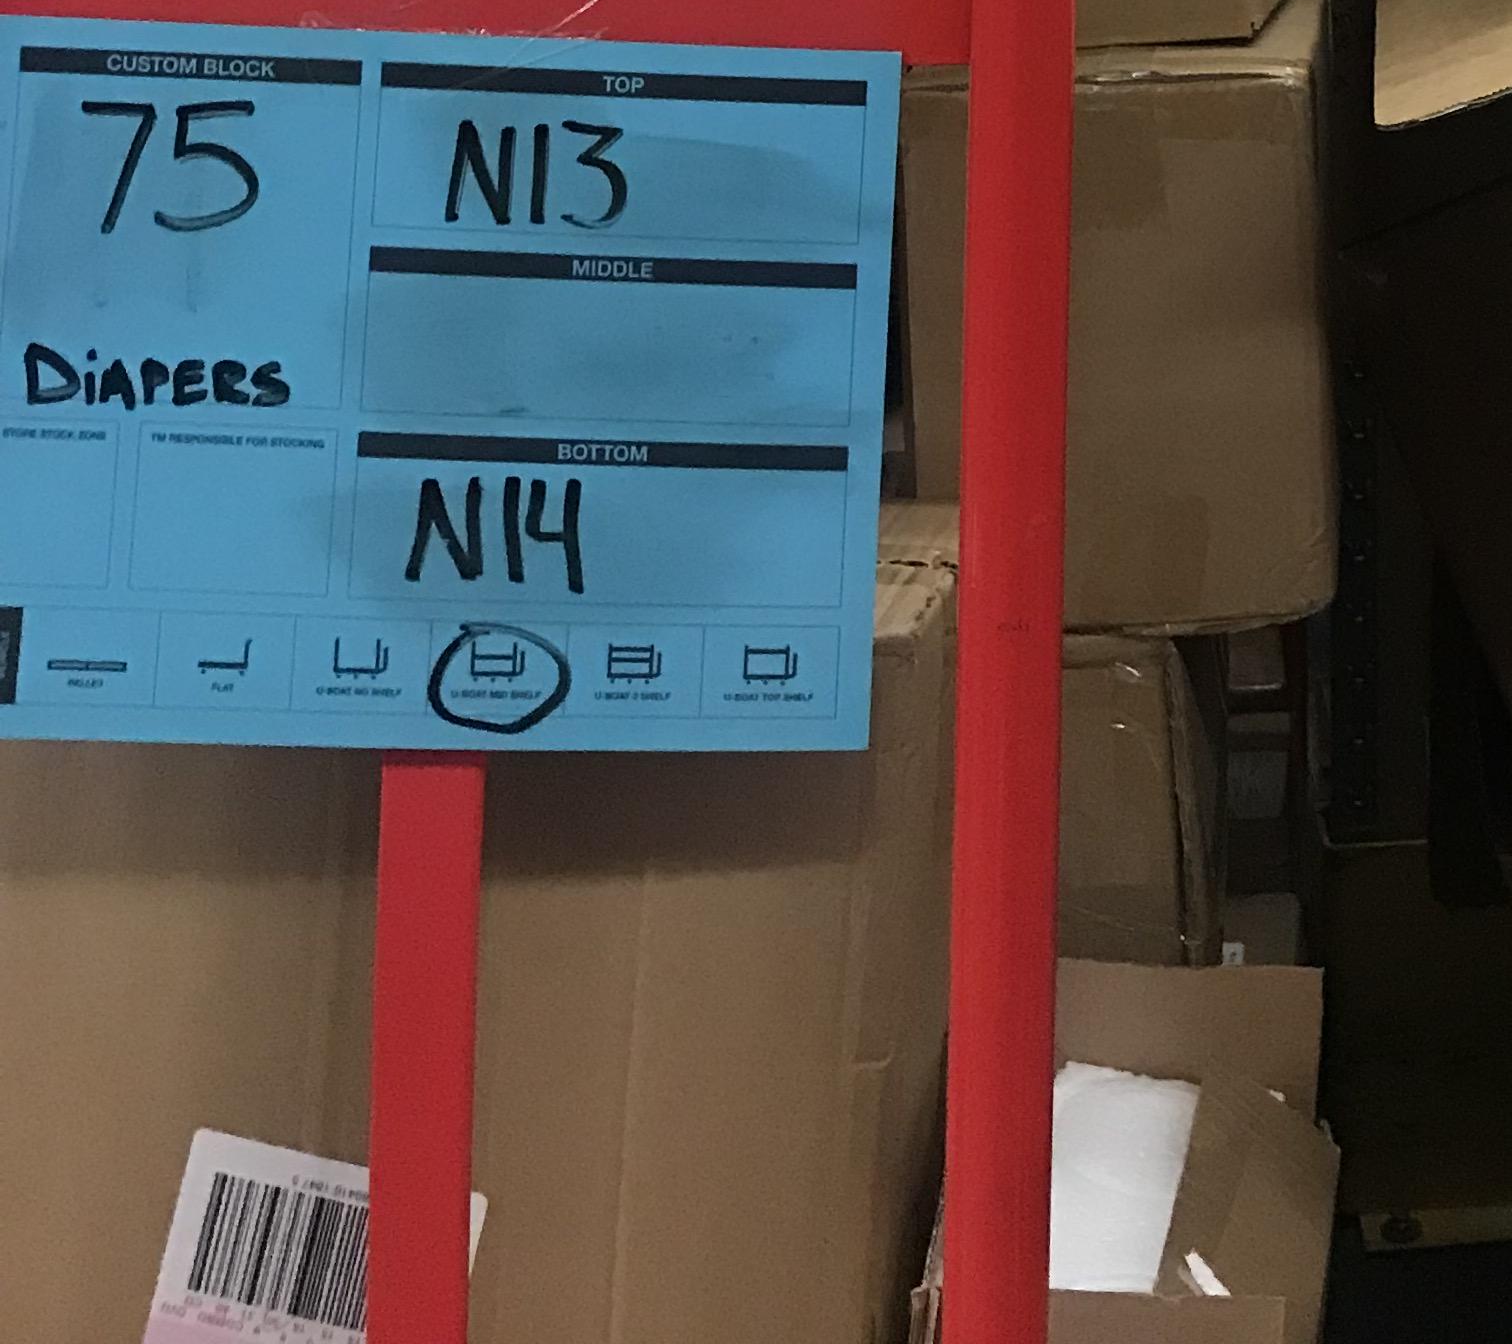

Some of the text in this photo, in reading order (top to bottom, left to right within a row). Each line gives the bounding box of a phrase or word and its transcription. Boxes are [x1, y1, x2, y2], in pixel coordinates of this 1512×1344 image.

[106, 53, 276, 80] CUSTOM BLOCK
[602, 75, 645, 95] TOP
[81, 100, 260, 235] 75
[445, 119, 630, 230] N13
[571, 258, 654, 281] MIDDLE
[246, 435, 268, 447] FOR
[270, 436, 325, 450] STOCKING
[556, 443, 649, 465] BOTTOM
[406, 476, 585, 594] N14
